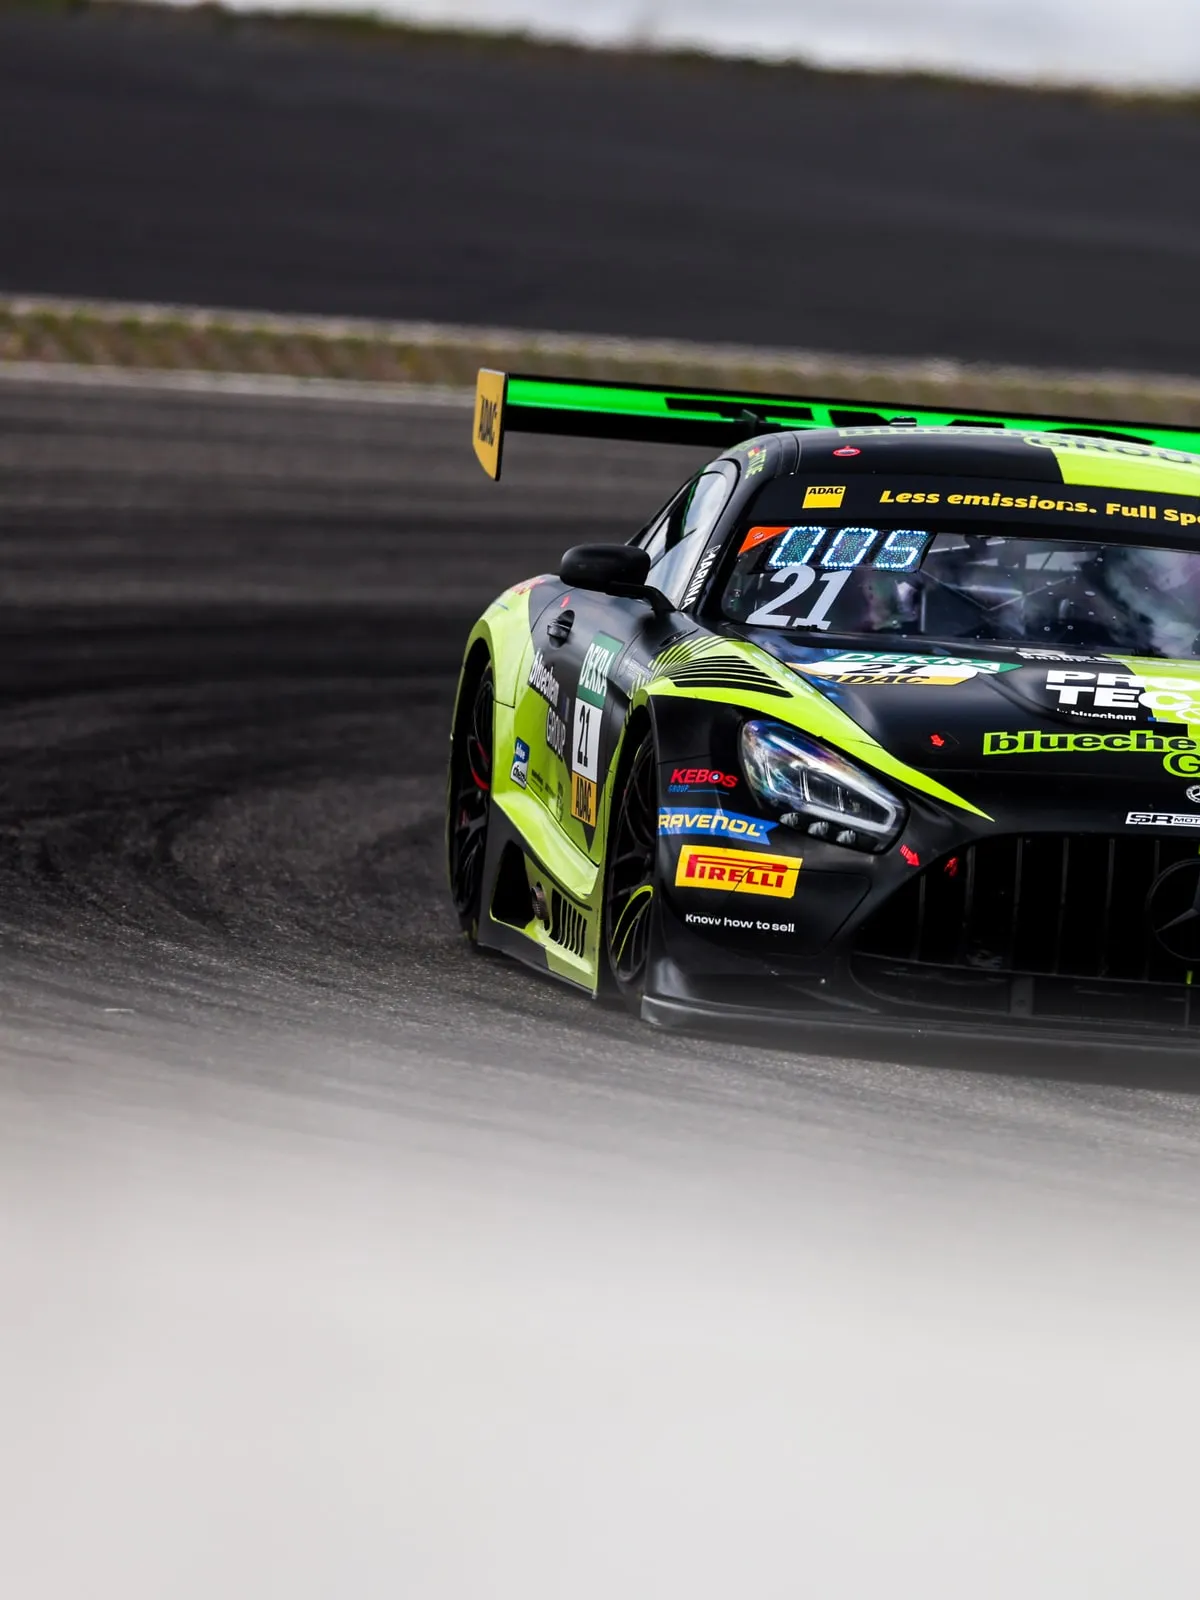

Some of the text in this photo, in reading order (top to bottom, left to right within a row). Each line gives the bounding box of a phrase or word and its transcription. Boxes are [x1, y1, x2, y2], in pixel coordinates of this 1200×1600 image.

[807, 487, 844, 495] ADAC
[879, 490, 940, 504] Less
[947, 493, 1097, 513] emissions.
[1105, 502, 1157, 519] Full
[680, 544, 721, 611] MARINA
[745, 565, 852, 631] 21
[579, 643, 614, 697] DEKRA
[831, 652, 1001, 673] DEKRA
[844, 663, 928, 674] 21
[817, 674, 931, 684] ADAC
[1045, 684, 1193, 711] TEC
[577, 704, 591, 768] 21
[667, 784, 690, 793] GROUP
[670, 768, 739, 788] KEBOS
[575, 776, 592, 823] ADAC
[658, 814, 761, 837] RAVENOL
[685, 854, 788, 889] PIRELLI
[685, 913, 795, 933] Know how to sell
